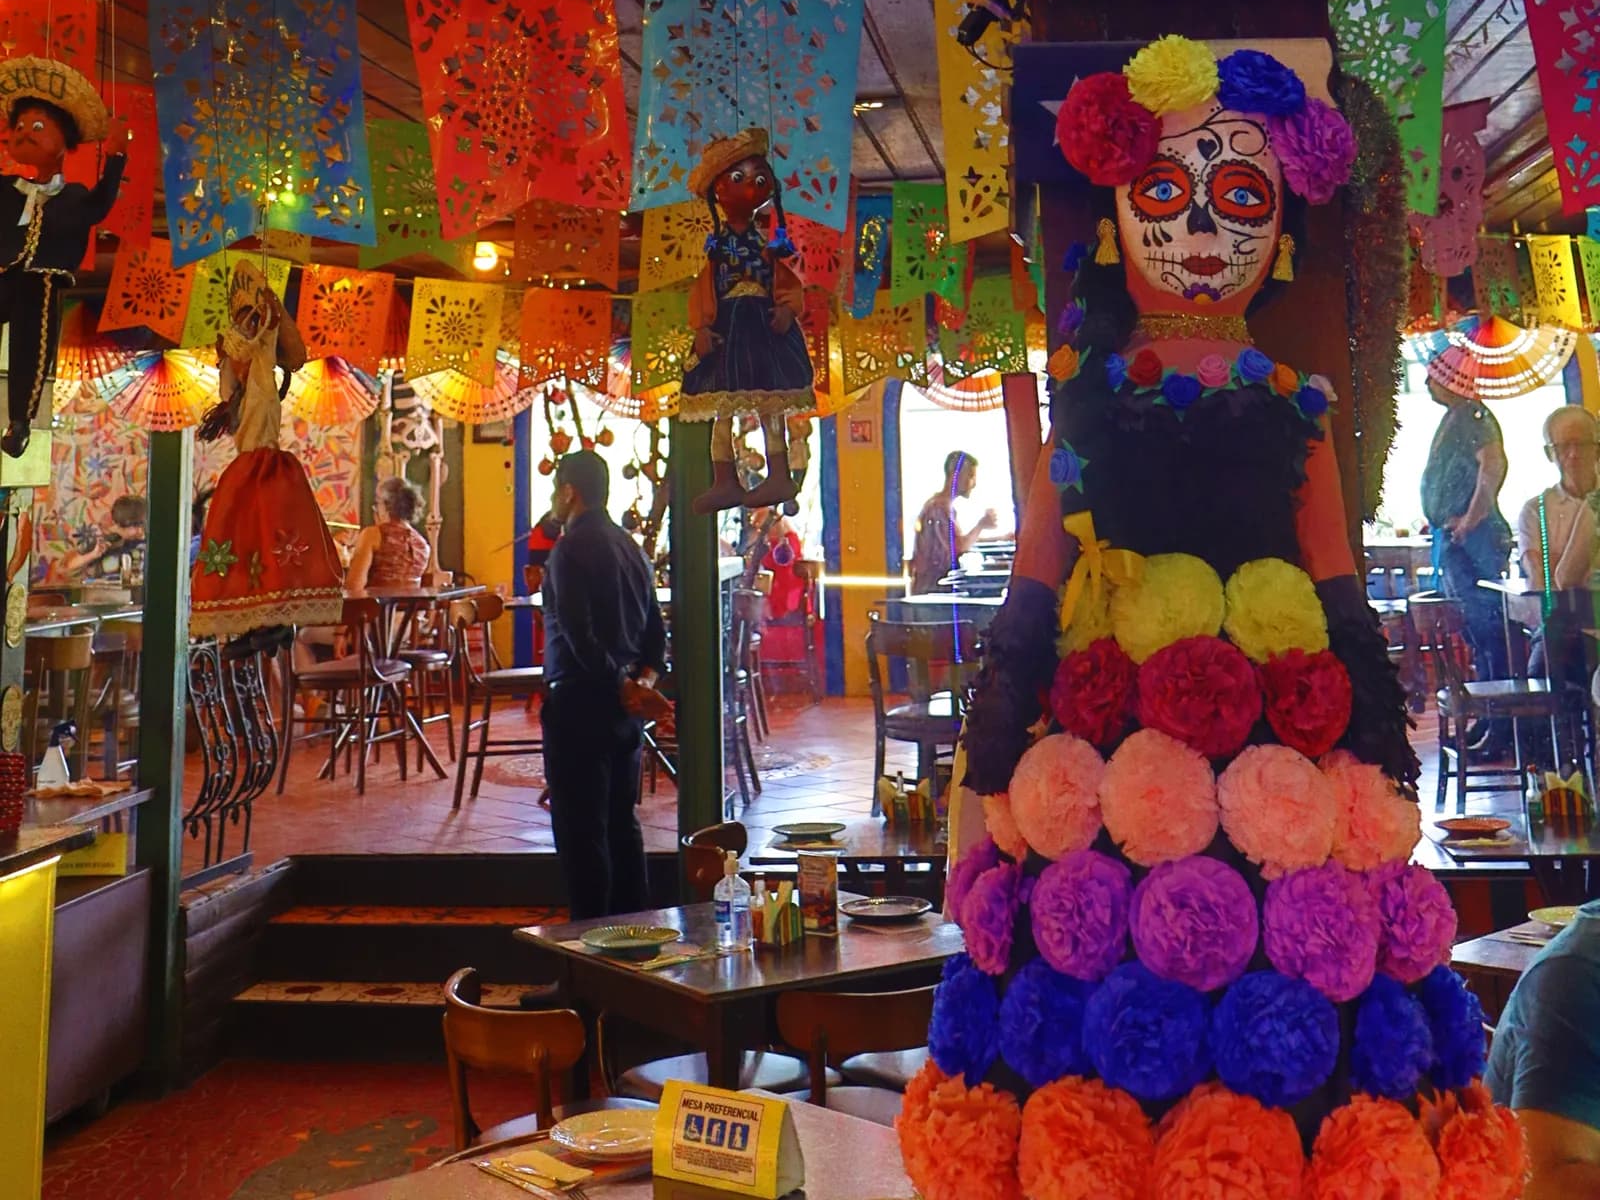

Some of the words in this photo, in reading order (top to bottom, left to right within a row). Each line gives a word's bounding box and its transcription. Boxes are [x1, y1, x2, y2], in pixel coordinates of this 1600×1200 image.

[0, 65, 67, 100] EXICO
[681, 1098, 703, 1112] MESA
[703, 1102, 760, 1122] PREFERENCIAL
